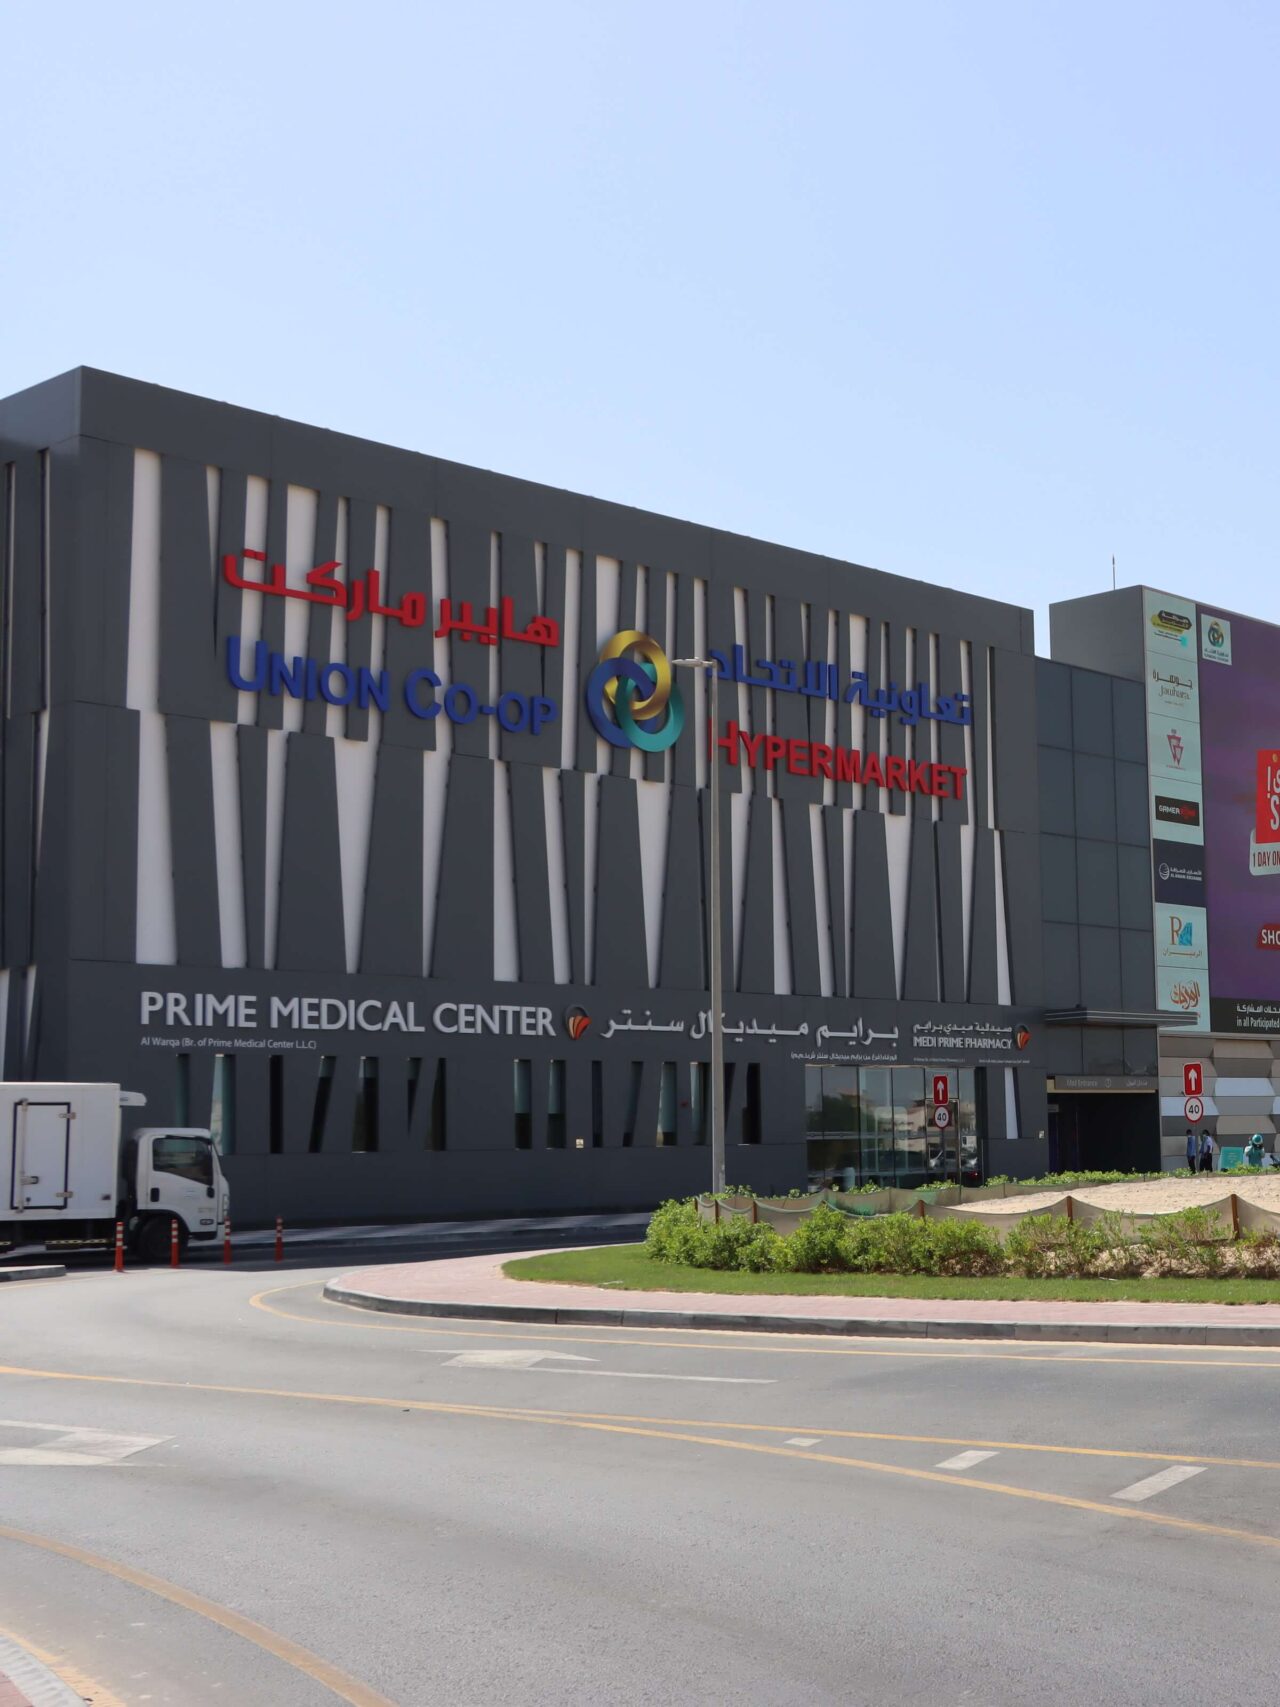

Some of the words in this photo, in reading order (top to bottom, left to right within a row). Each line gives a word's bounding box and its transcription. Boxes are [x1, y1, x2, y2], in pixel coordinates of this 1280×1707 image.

[222, 549, 427, 628] ماركت
[434, 596, 560, 647] هايبر
[227, 635, 391, 713] UNION
[404, 668, 558, 737] CO-OP
[708, 644, 839, 701] الاتحاد
[843, 669, 973, 727] تعاونية
[708, 717, 968, 801] HYPERMARKET
[1257, 851, 1271, 867] DAY
[140, 991, 257, 1028] PRIME
[270, 996, 426, 1034] MEDICAL
[432, 1002, 557, 1037] CENTER
[600, 1007, 685, 1040] سنتر
[912, 1020, 943, 1034] برايم
[975, 1021, 1013, 1035] صيدلية
[1250, 1017, 1280, 1031] Participated
[151, 1037, 180, 1048] Warqa
[197, 1037, 207, 1047] of
[208, 1038, 233, 1048] Prime
[233, 1038, 266, 1049] Medical
[267, 1039, 294, 1049] Center
[815, 1016, 899, 1047] برايم
[912, 1036, 937, 1048] MEDI
[938, 1037, 964, 1049] PRIME
[965, 1037, 1013, 1050] PHARMACY
[936, 1112, 947, 1122] 40
[1188, 1104, 1200, 1115] 40
